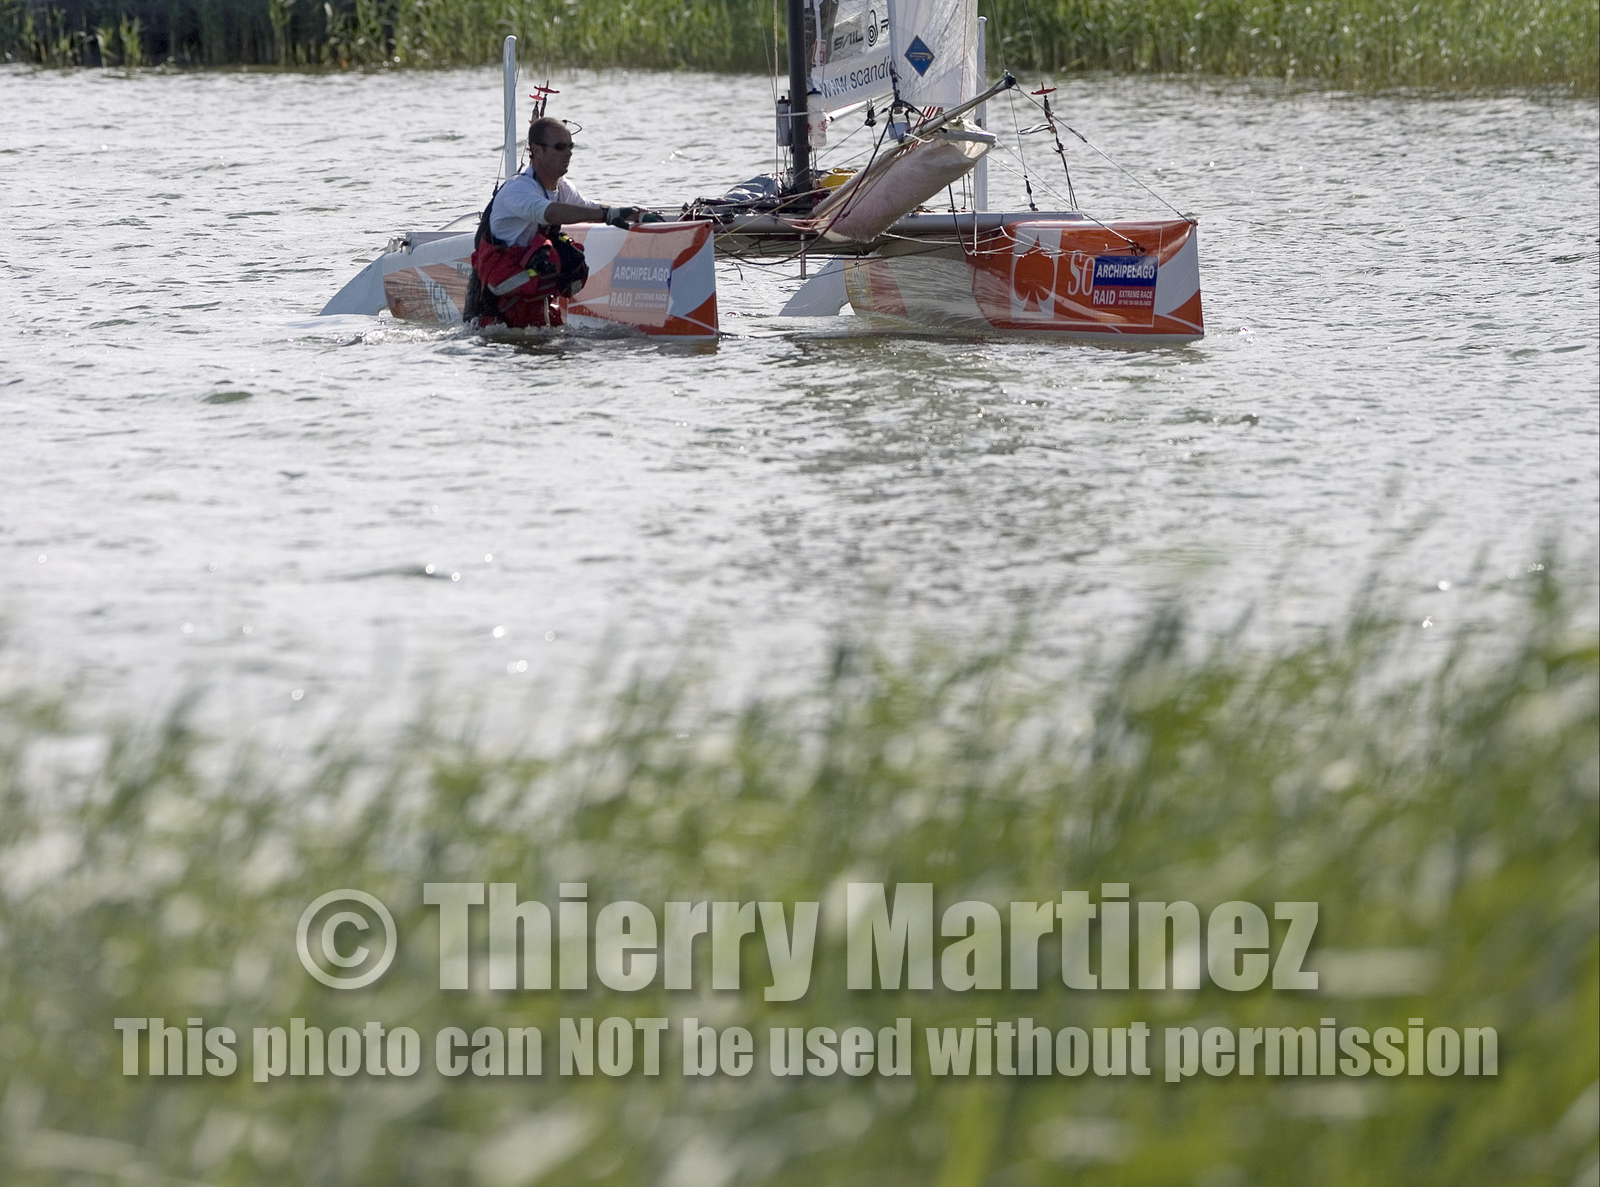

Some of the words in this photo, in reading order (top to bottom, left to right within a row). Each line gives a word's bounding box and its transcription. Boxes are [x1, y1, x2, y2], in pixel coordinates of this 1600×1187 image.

[614, 266, 670, 282] ARCHIPELAGO
[1096, 263, 1155, 279] ARCHIPELAGO
[610, 292, 632, 307] RAID
[1093, 289, 1115, 305] RAID
[1119, 290, 1139, 299] EXTREME
[1140, 290, 1153, 299] RACE
